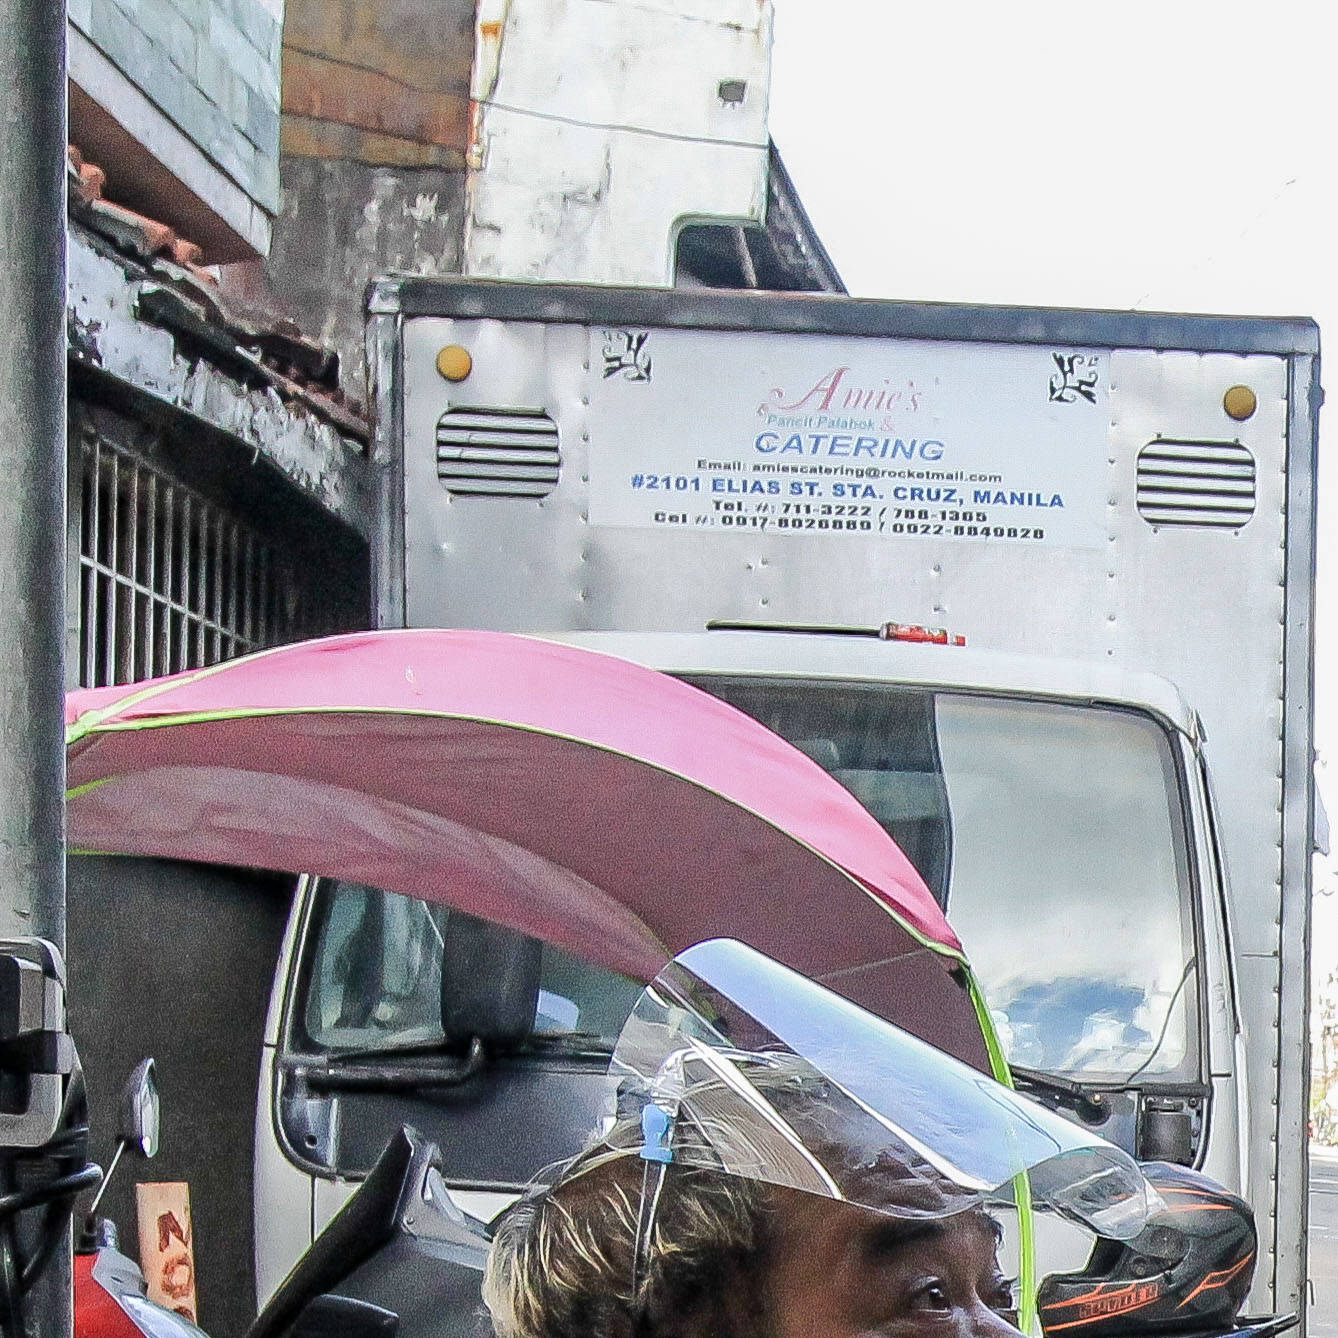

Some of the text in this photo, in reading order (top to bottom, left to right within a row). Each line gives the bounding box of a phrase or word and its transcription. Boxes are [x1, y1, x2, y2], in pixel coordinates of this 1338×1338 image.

[770, 367, 923, 412] Amie's
[766, 414, 895, 433] Pancit Palabok &
[754, 430, 945, 461] CATERING
[696, 459, 1003, 484] Email: amiescatering@rocketmail.com
[631, 473, 1065, 508] #2101 ELIAS ST. STA. CRUZ, MANILA
[654, 512, 688, 524] Cel
[712, 500, 748, 513] Tel.
[781, 502, 872, 517] 711-3222
